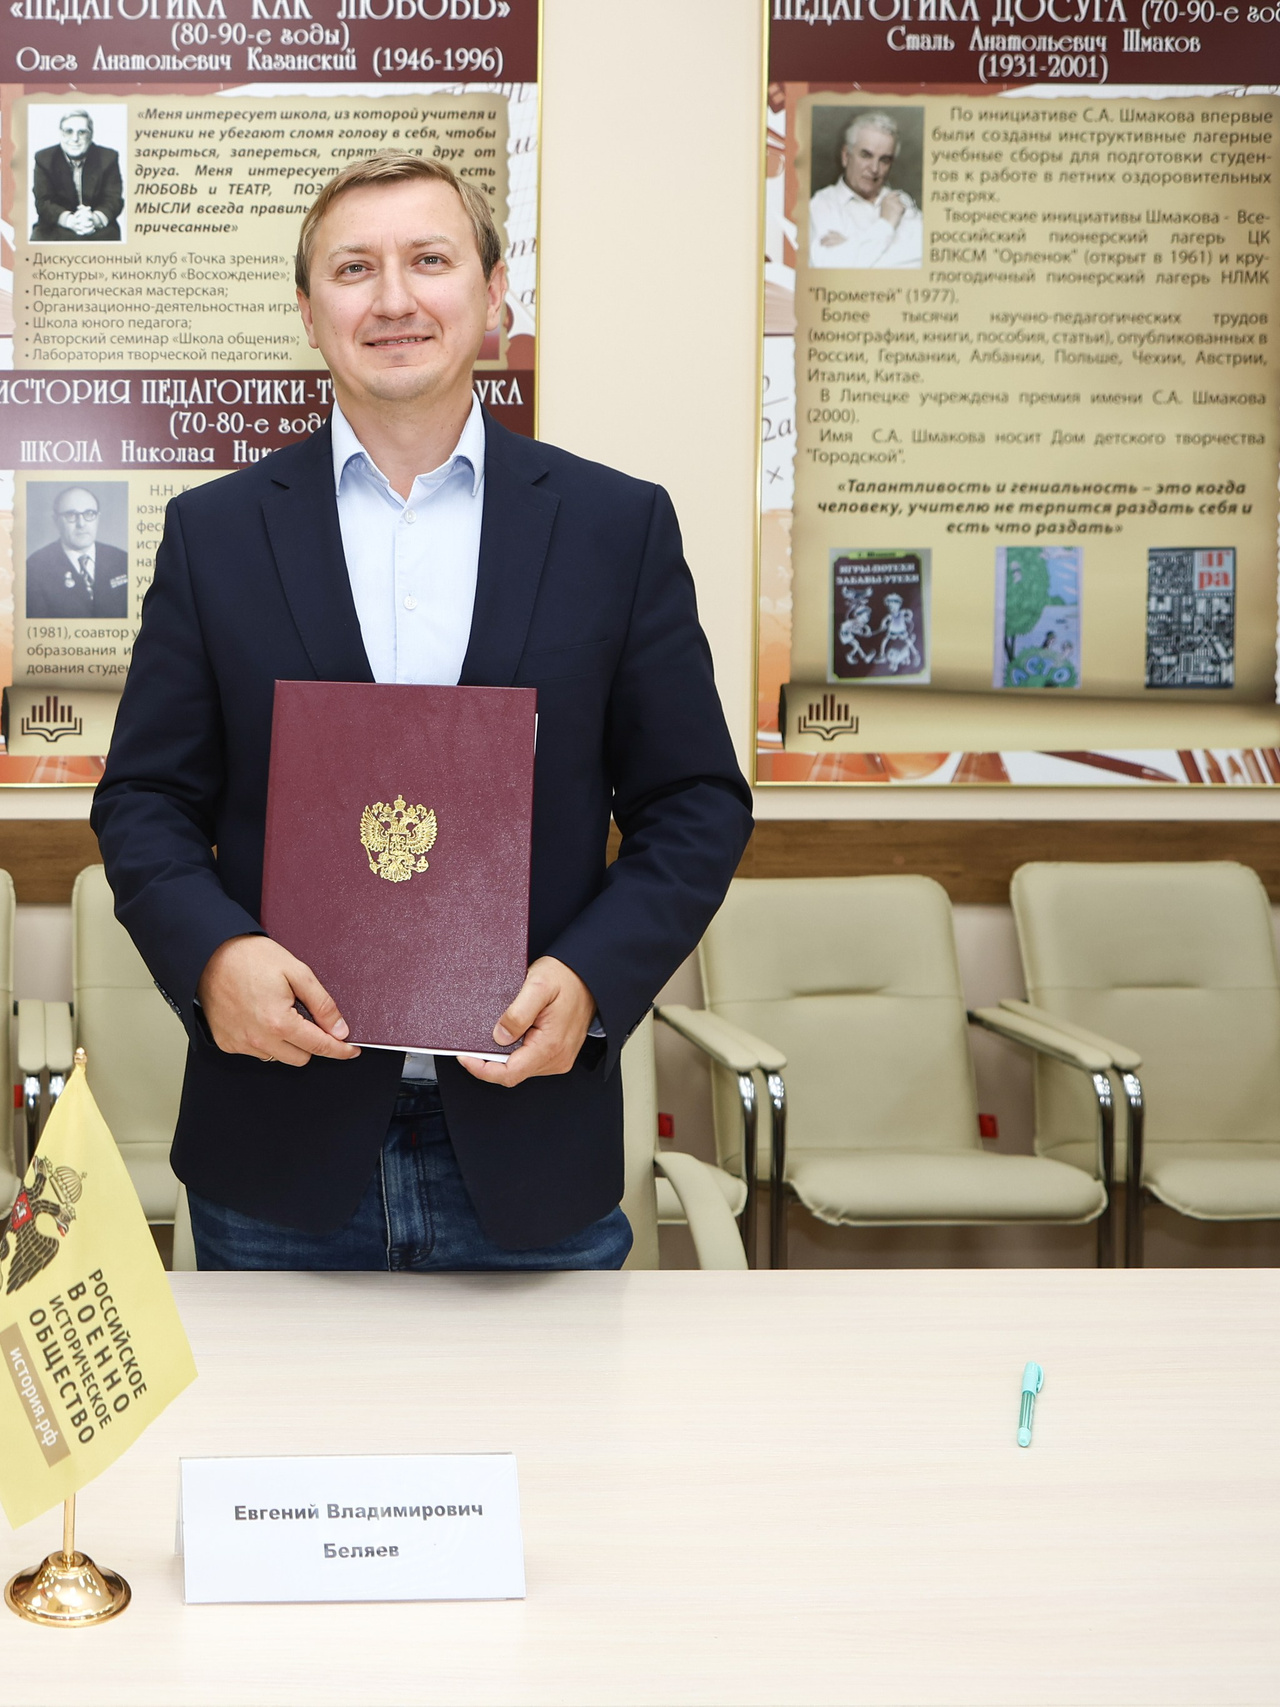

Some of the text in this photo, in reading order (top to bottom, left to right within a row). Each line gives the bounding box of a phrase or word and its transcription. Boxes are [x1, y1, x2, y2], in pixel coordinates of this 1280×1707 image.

[251, 0, 313, 20] КАК
[773, 0, 980, 25] ПЕДАГОГИКА
[991, 0, 1128, 26] ДОСУГА
[1141, 0, 1240, 29] (70-90-е
[171, 21, 350, 51] (80-90-е годы)
[886, 25, 1202, 52] Сталь Анатольевич Шмаков
[16, 45, 504, 77] Олег Анатольевич Казанский (1946-1996)
[978, 52, 1109, 84] (1931-2001)
[137, 107, 497, 123] «Меня интересует школа, из которой учителя и
[950, 106, 1274, 127] По инициативе С.А. Шмакова впервые
[134, 223, 239, 236] причесанные»
[32, 251, 289, 268] Дискуссионный клуб «Точка зрения»,
[31, 267, 291, 284] «Контуры», киноклуб «Восхождение»;
[905, 287, 959, 305] (1977).
[32, 300, 265, 316] Организационно-деятельностная
[32, 316, 192, 331] Школа юного педагога;
[32, 347, 293, 364] Лаборатория творческой педагогики.
[476, 377, 524, 405] УКА
[169, 410, 327, 440] (70-80-е год
[806, 407, 860, 425] (2000).
[21, 440, 215, 462] ШКОЛА Николая
[837, 478, 1247, 495] «Талантливость и гениальность это когда
[817, 499, 1253, 516] человеку, учителю не терпится раздать себя и
[946, 518, 1123, 536] есть что раздать»
[88, 1268, 148, 1399] РОССИЙСКОЕ
[67, 1281, 130, 1413] ВОЕННО
[49, 1294, 112, 1429] ИСТОРИЧЕСКОЕ
[29, 1308, 95, 1443] ОБЩЕСТВО
[9, 1346, 59, 1447] история.рф
[234, 1502, 484, 1522] Евгений Владимирович
[323, 1542, 400, 1559] Беляев
